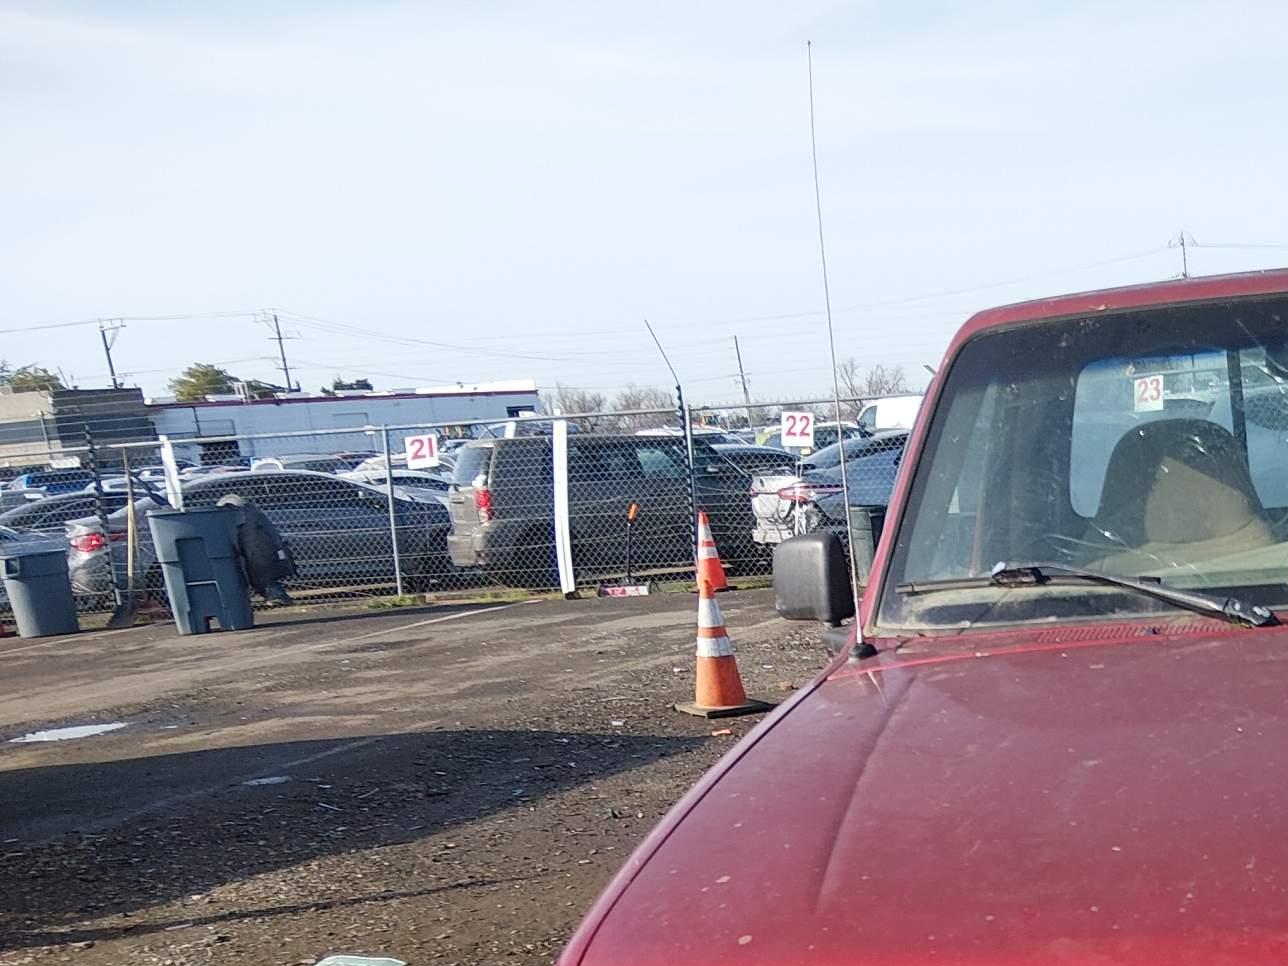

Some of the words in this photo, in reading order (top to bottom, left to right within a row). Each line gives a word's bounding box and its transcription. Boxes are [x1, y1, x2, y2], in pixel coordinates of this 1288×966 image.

[1137, 378, 1161, 402] 23
[785, 415, 810, 437] 22
[409, 437, 435, 460] 21
